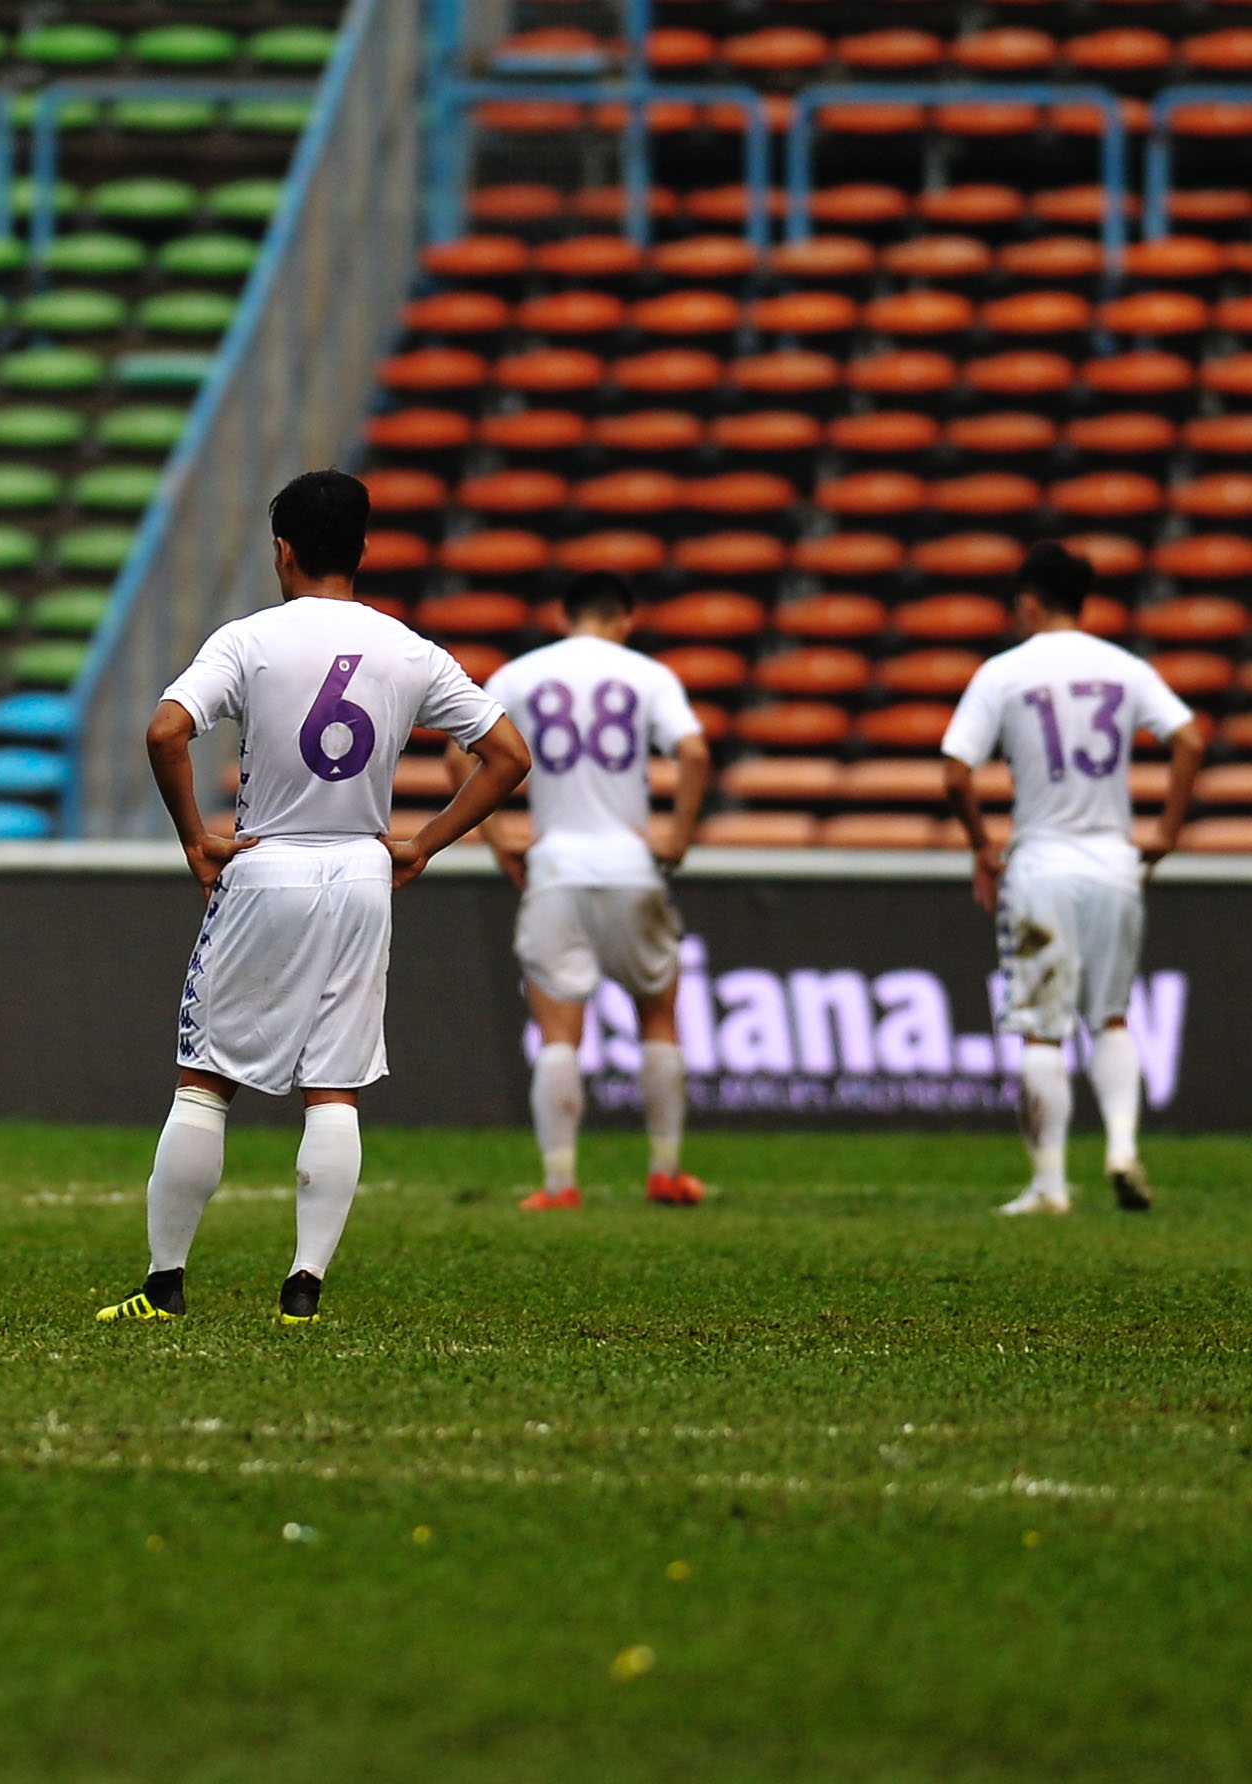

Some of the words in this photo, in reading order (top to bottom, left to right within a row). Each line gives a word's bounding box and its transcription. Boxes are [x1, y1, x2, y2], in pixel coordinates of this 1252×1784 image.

[299, 654, 376, 783] 6
[527, 678, 639, 776] 88
[1022, 681, 1125, 783] 13
